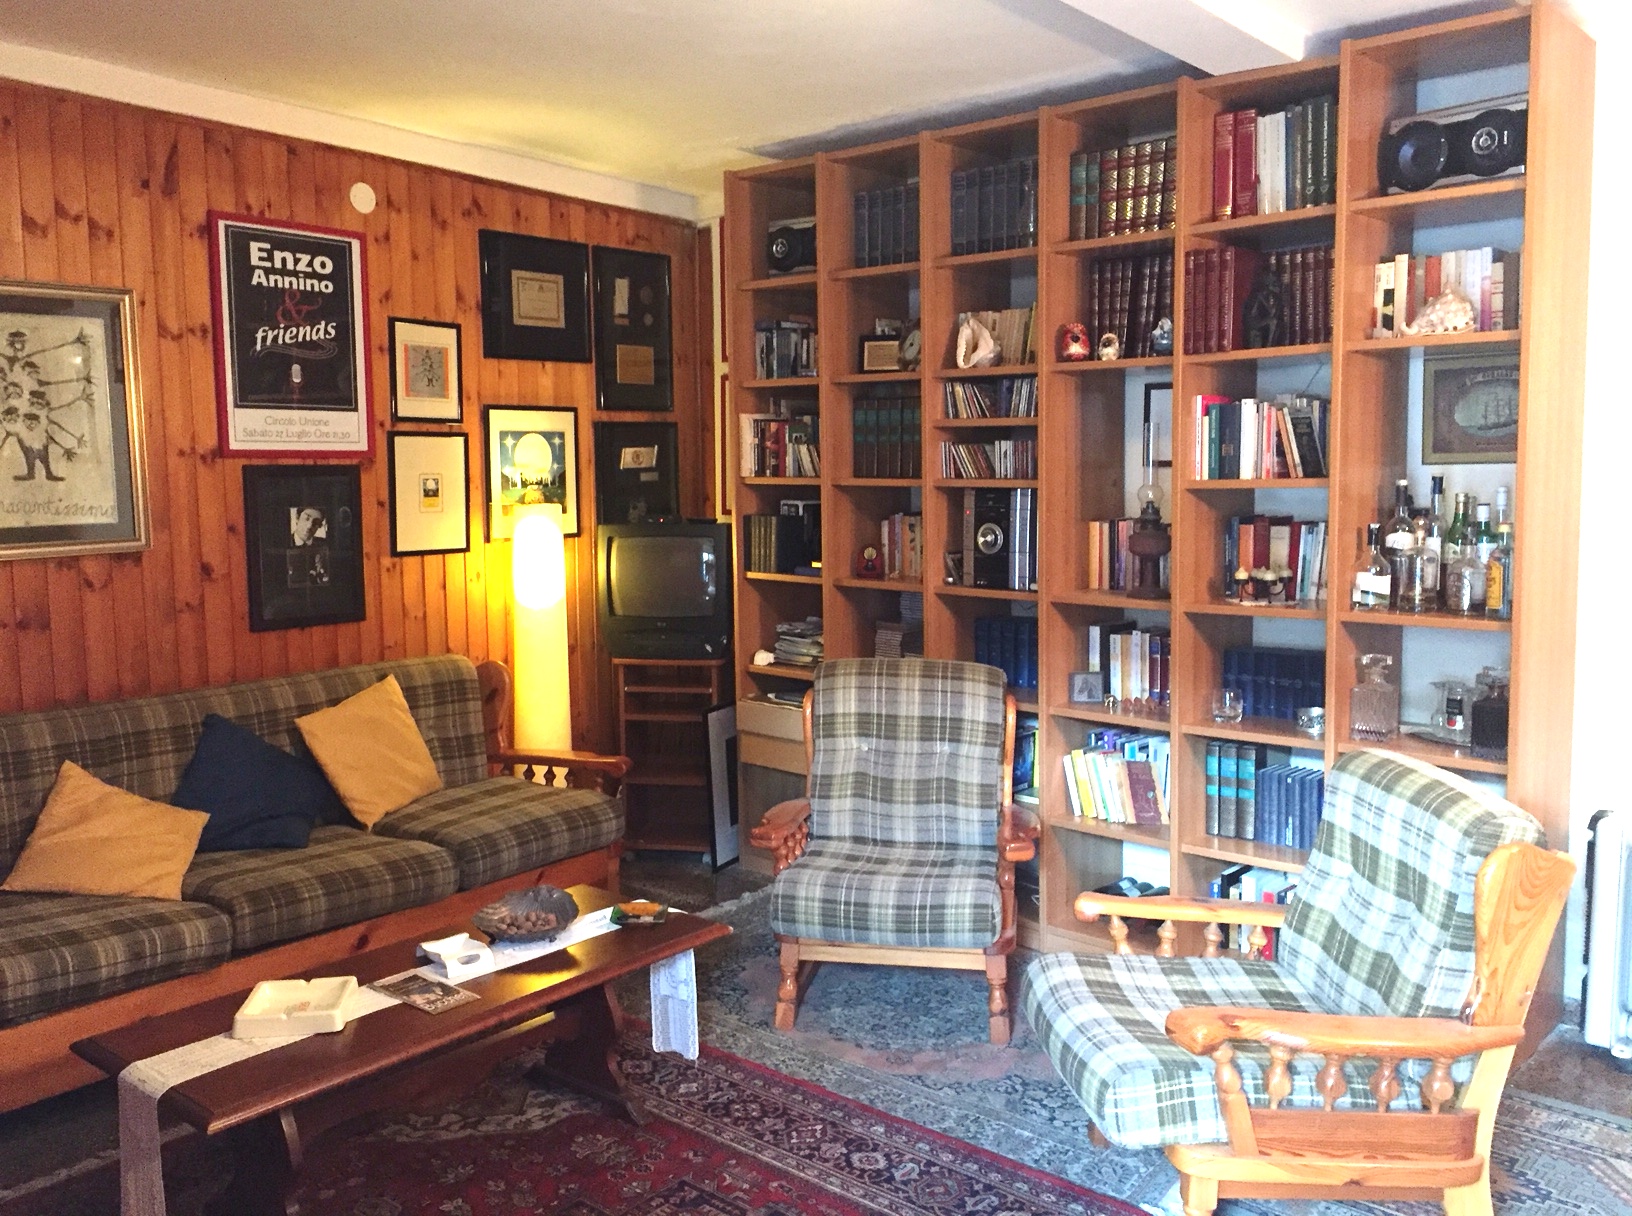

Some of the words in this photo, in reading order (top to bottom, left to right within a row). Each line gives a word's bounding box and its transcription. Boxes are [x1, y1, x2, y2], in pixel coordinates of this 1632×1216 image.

[249, 241, 333, 275] Enzo
[251, 268, 334, 294] Annino
[275, 288, 322, 327] &
[255, 320, 337, 352] friends
[242, 427, 274, 438] Sabato
[285, 428, 312, 440] Luglio
[313, 428, 331, 439] Ore
[264, 415, 297, 426] Circolo
[299, 416, 330, 427] Unione
